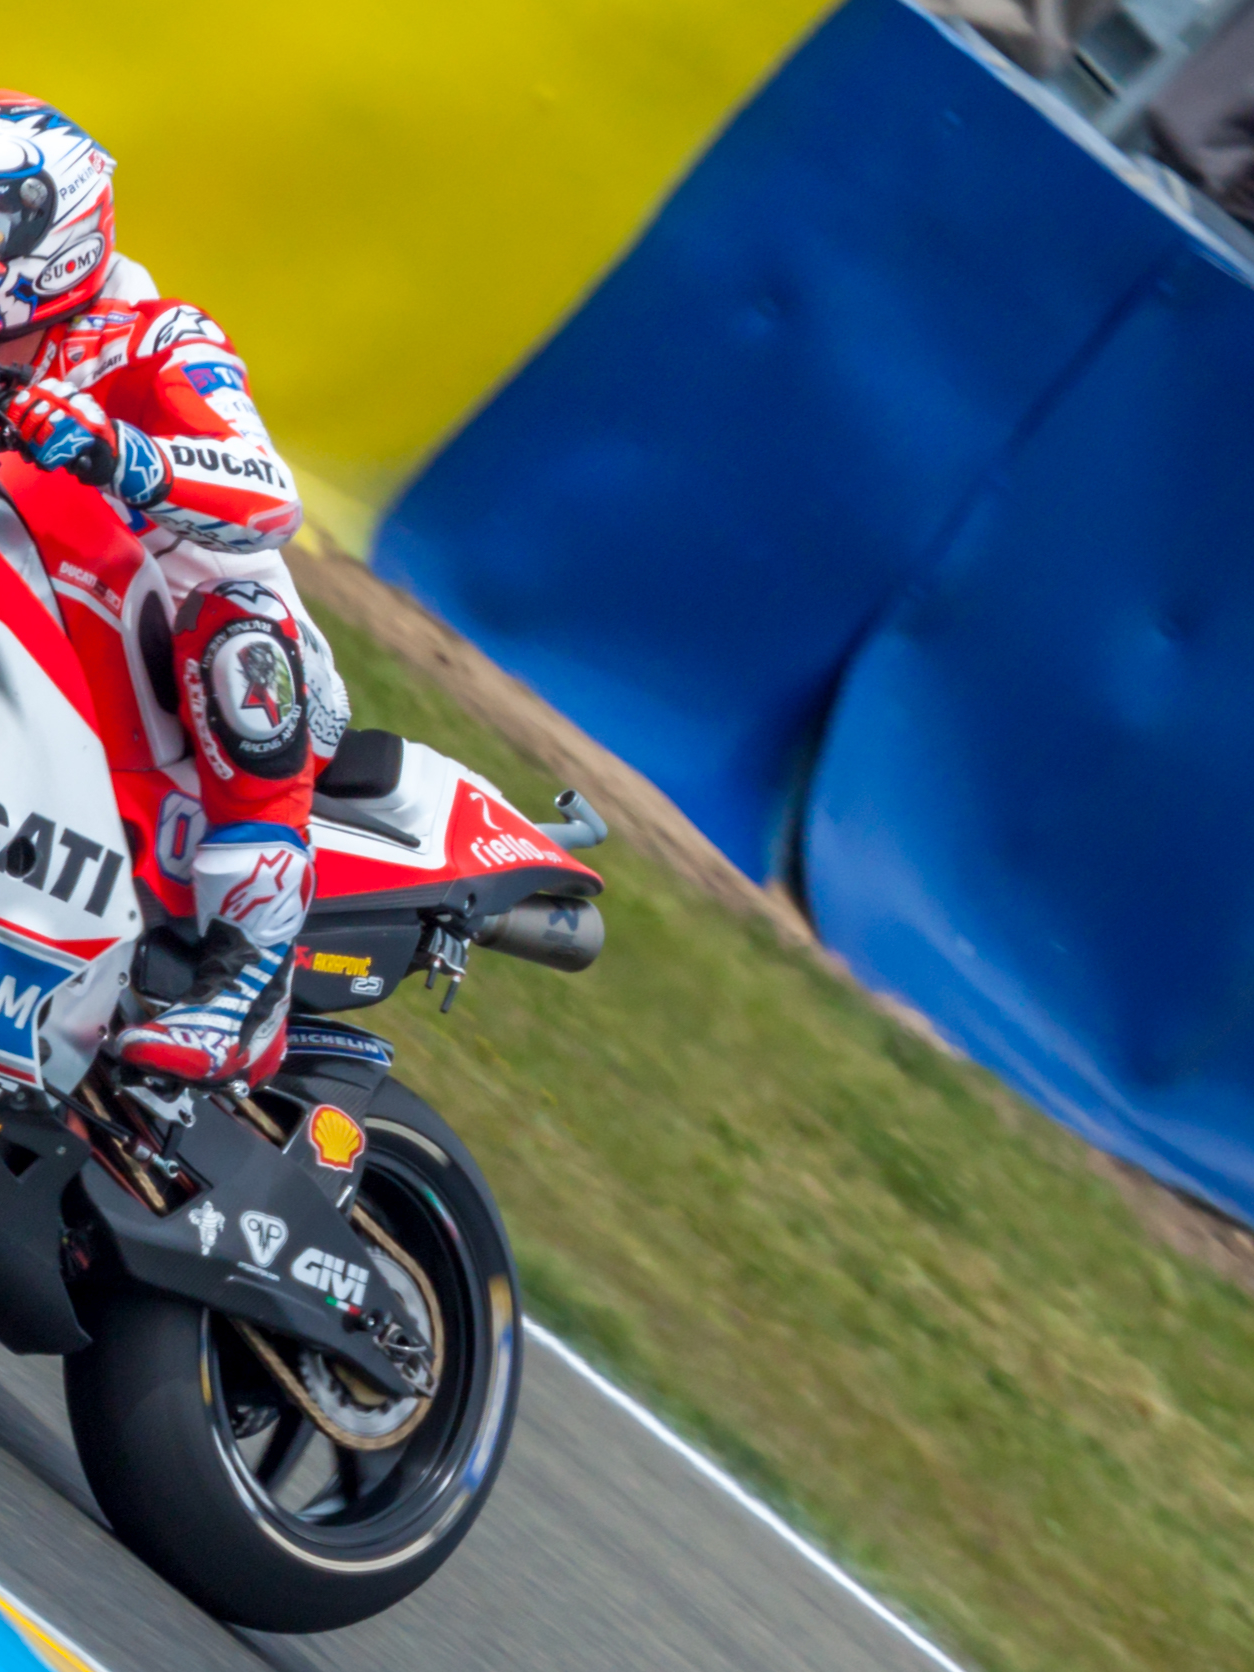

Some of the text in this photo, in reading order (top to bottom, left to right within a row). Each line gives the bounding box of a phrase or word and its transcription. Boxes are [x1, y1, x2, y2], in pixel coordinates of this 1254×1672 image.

[44, 246, 101, 282] SUOMY
[170, 444, 286, 489] DUCATI
[470, 833, 545, 868] riello
[291, 1247, 370, 1306] GIVI
